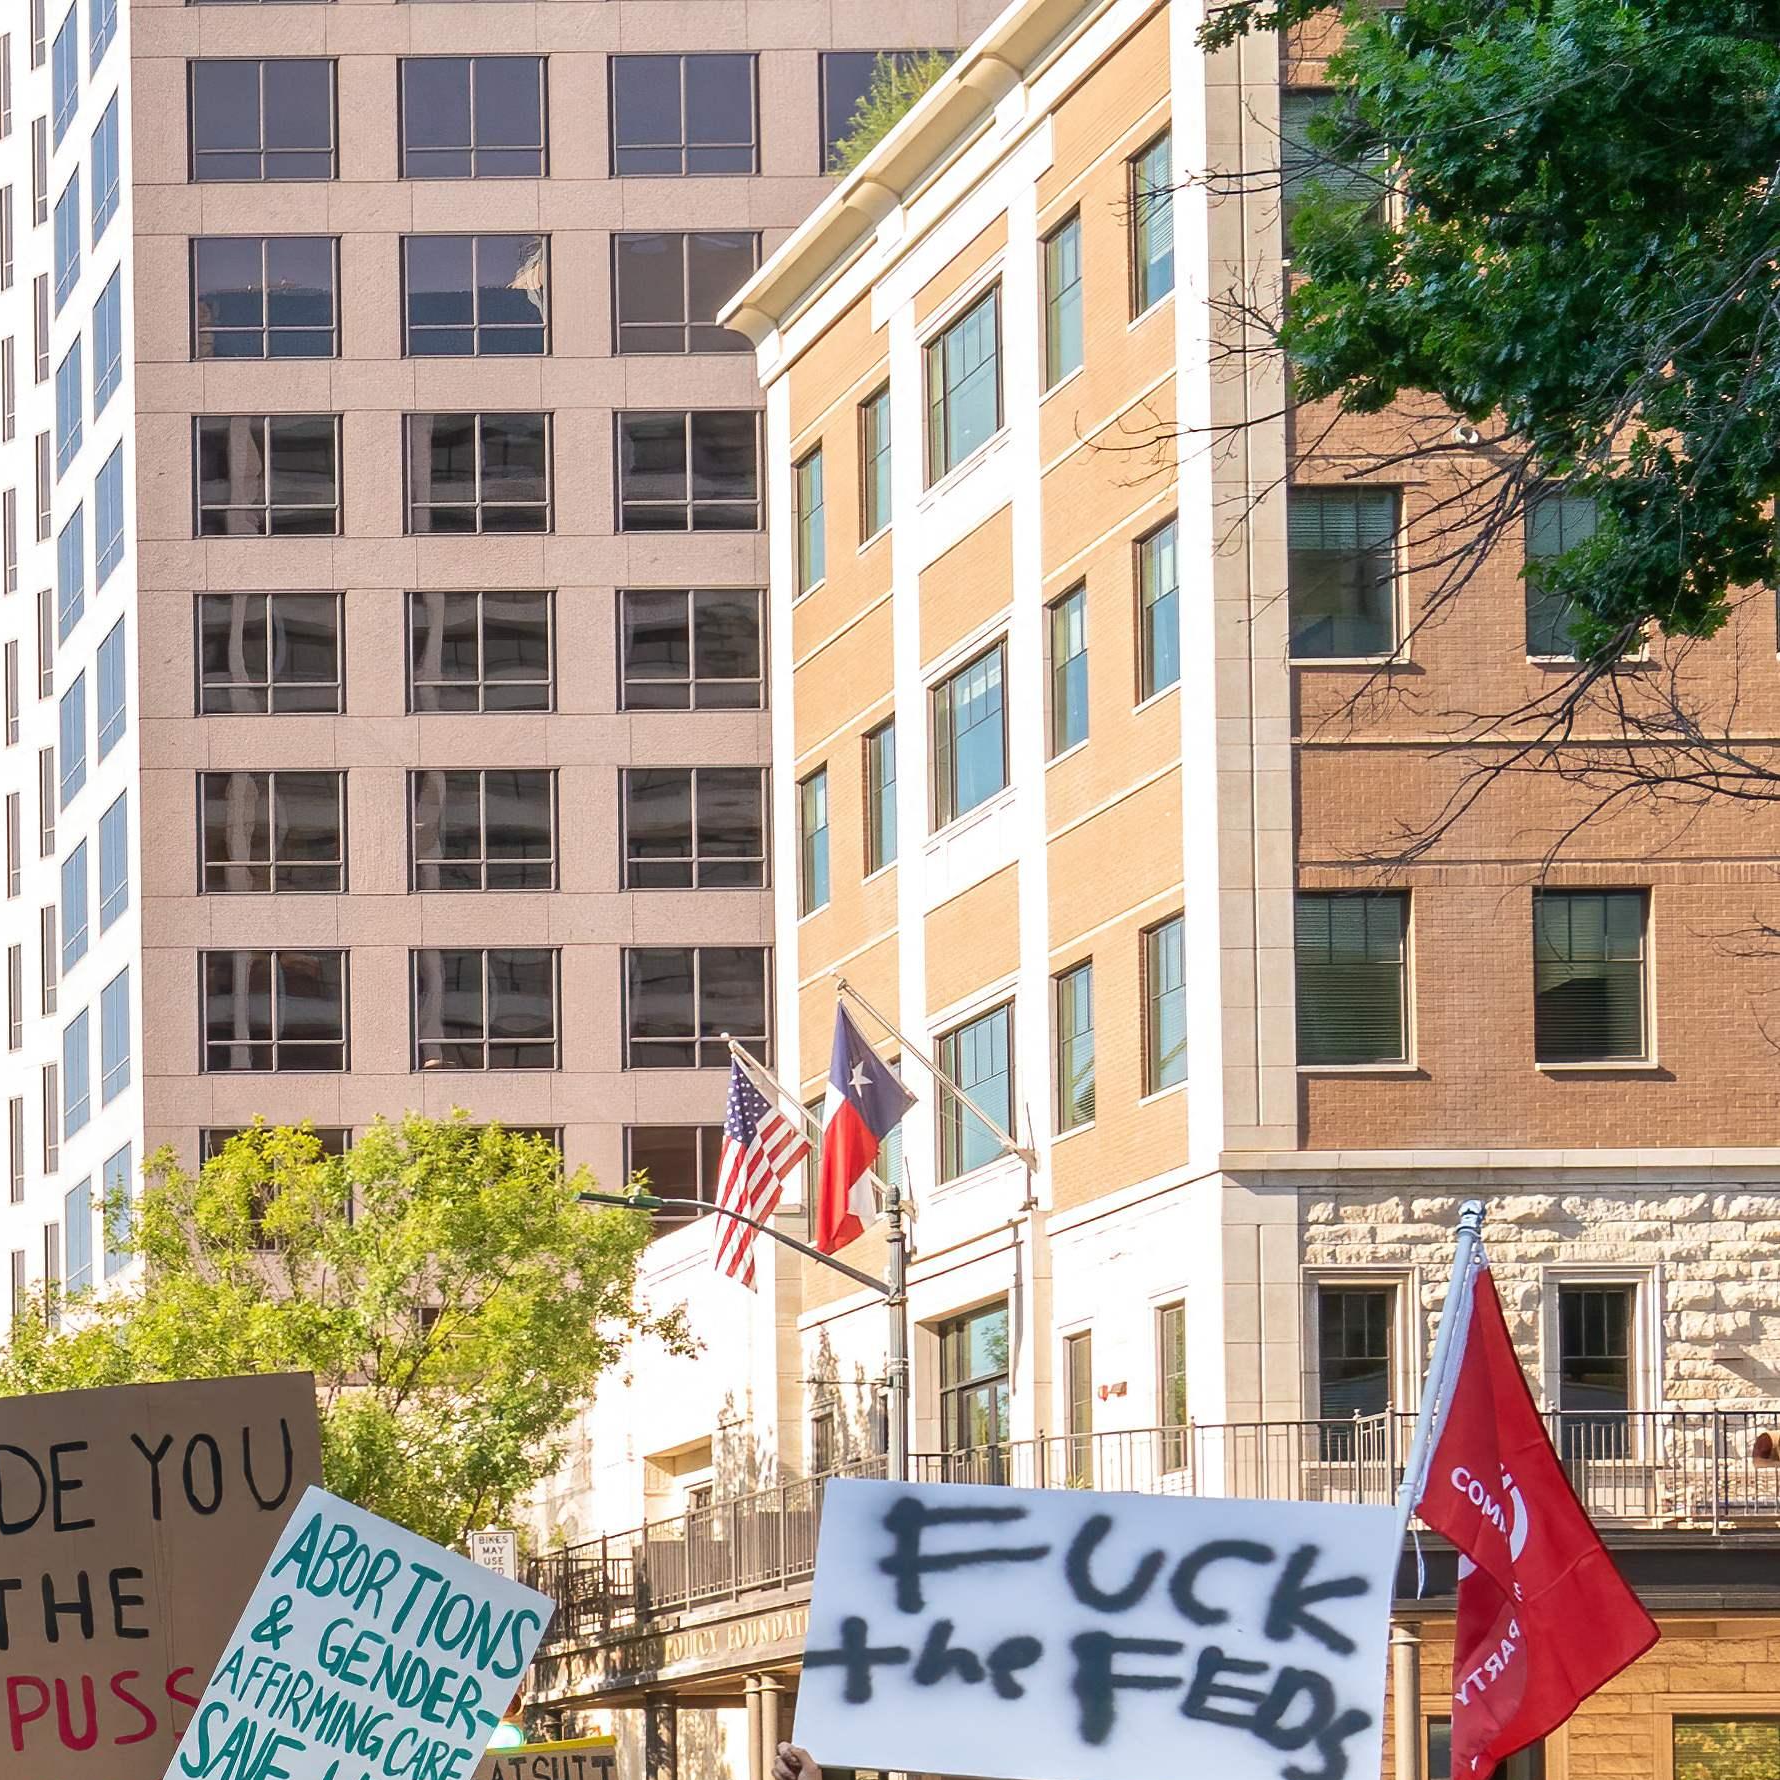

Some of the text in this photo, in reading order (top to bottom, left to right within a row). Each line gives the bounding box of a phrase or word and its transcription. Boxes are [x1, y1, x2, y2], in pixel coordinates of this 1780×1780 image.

[130, 1417, 293, 1520] YOU
[479, 1536, 508, 1544] BIKES
[484, 1557, 504, 1566] USE
[877, 1497, 1372, 1656] FUCK
[271, 1513, 540, 1679] ABORTIONS
[665, 1629, 718, 1665] POLICY
[211, 1646, 394, 1763] AFFIRMING
[251, 1594, 500, 1740] & GENDER-
[803, 1615, 1045, 1704] the
